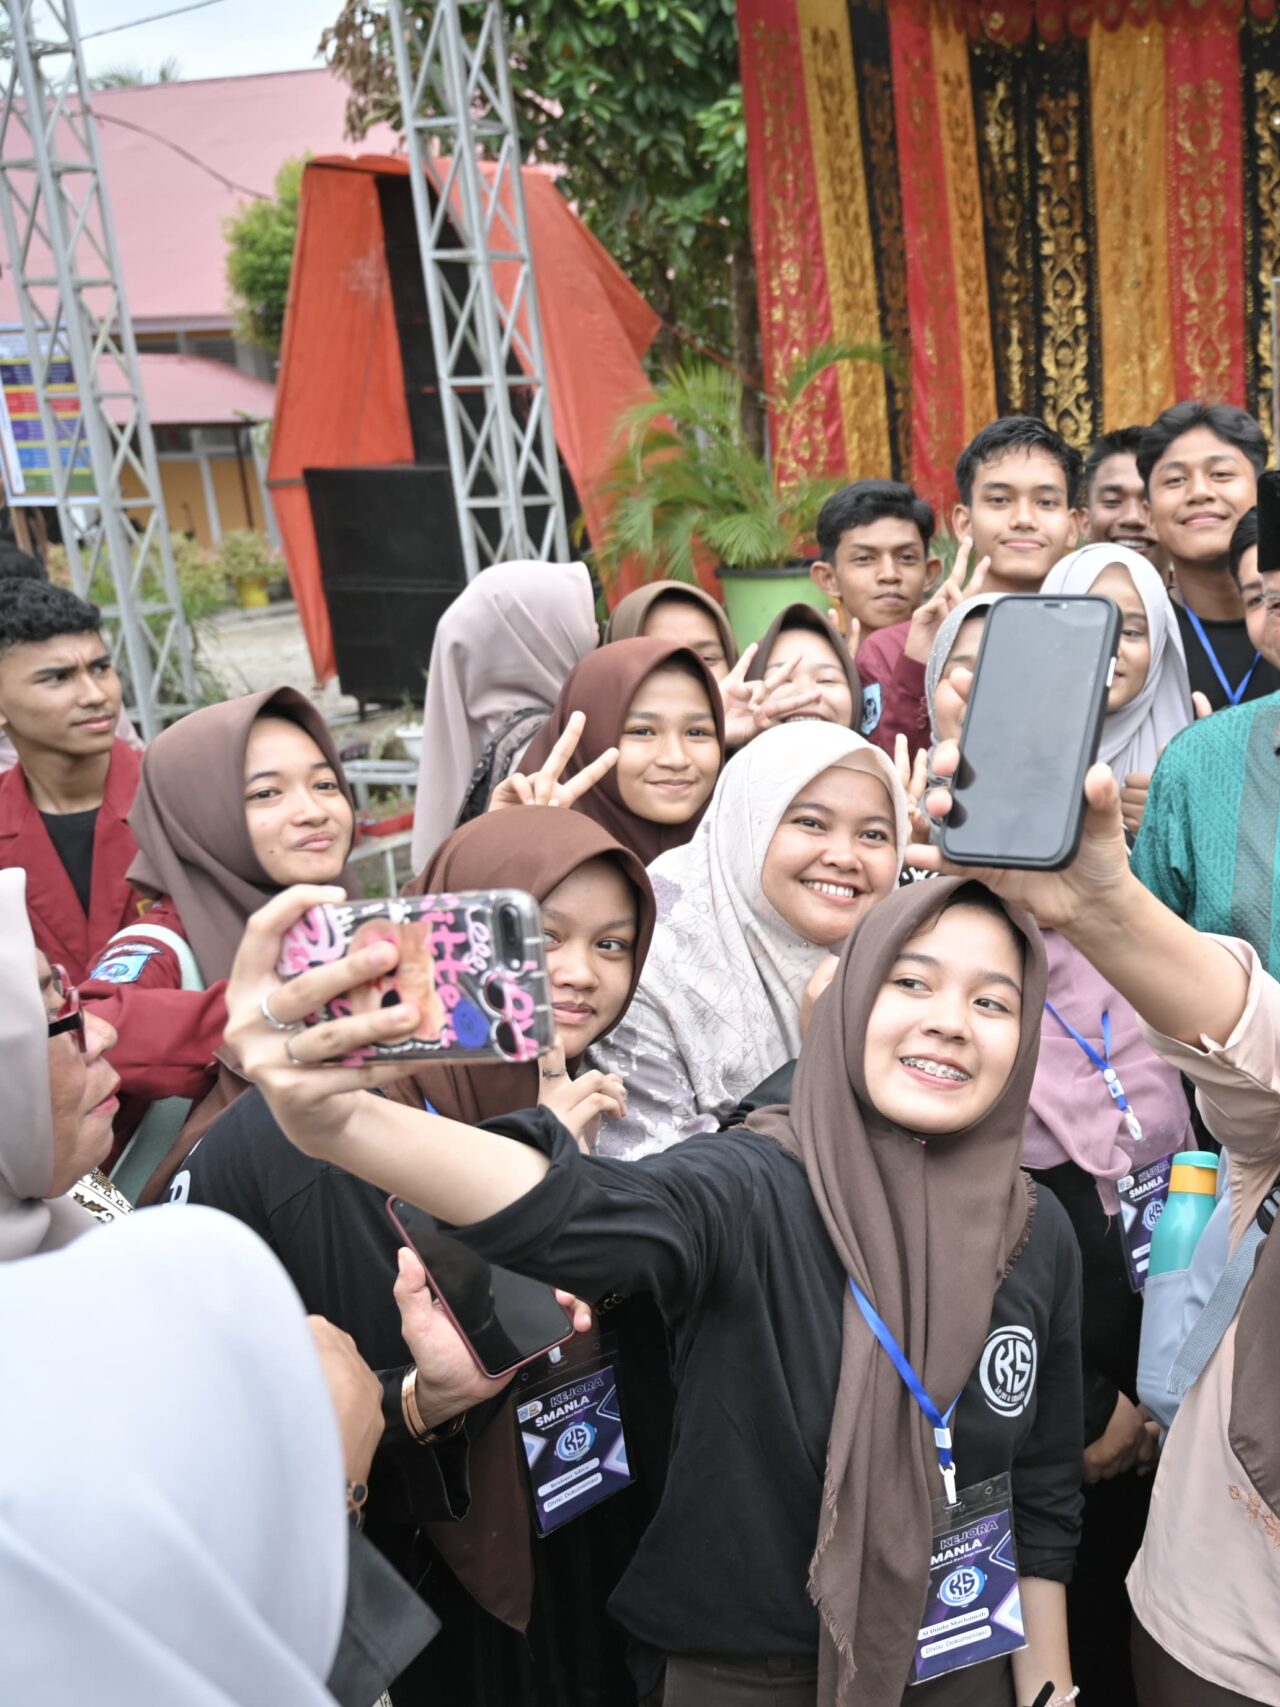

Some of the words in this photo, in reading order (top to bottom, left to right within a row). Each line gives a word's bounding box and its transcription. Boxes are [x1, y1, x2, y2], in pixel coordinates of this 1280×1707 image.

[1129, 1176, 1164, 1198] SMANLA
[995, 1340, 1031, 1394] KS
[550, 1377, 605, 1408] KEJORA
[535, 1395, 591, 1428] SMANLA
[564, 1427, 588, 1453] KS
[940, 1520, 999, 1550] KEJORA
[930, 1538, 983, 1566] MANLA
[949, 1572, 976, 1596] KS
[925, 1643, 942, 1655] Divisi
[945, 1629, 989, 1650] Dokumentasi
